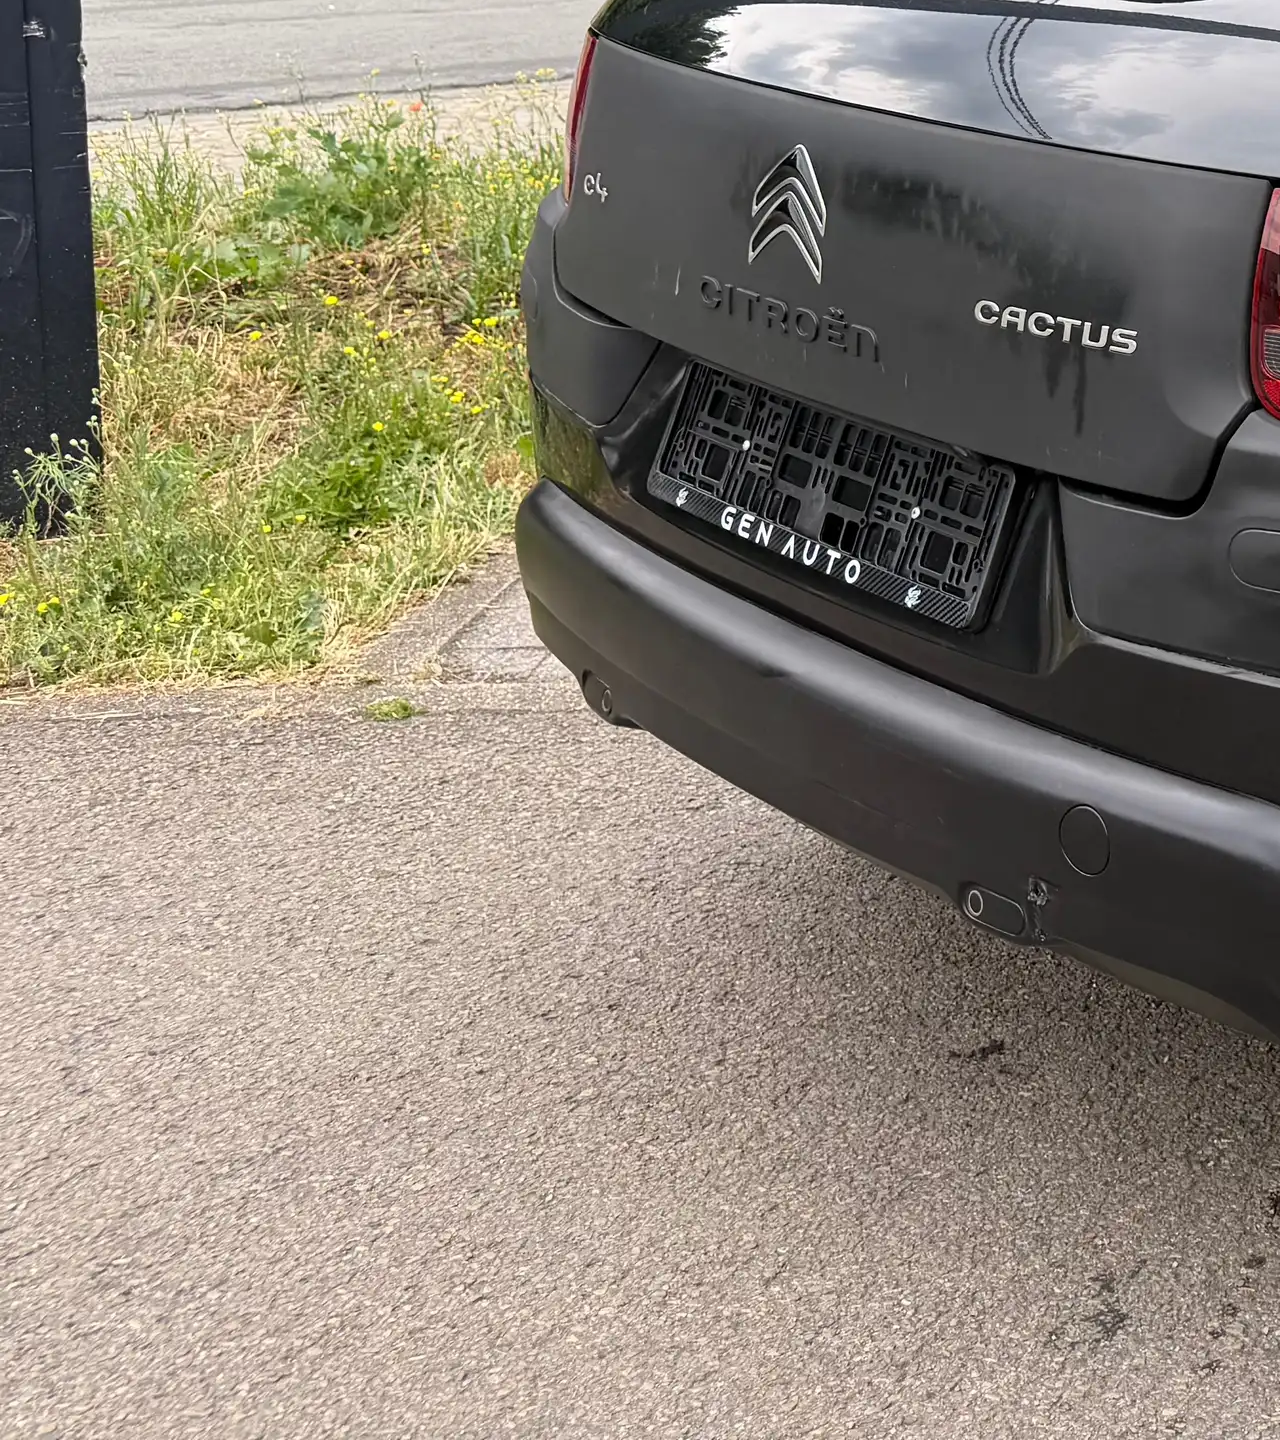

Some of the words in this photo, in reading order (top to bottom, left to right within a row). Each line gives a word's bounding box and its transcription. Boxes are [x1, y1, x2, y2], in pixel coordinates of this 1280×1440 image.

[583, 172, 609, 203] C4
[700, 274, 880, 363] CITROËN
[974, 299, 1140, 356] CACTUS
[720, 506, 777, 547] GEN
[781, 535, 861, 584] AUTO
